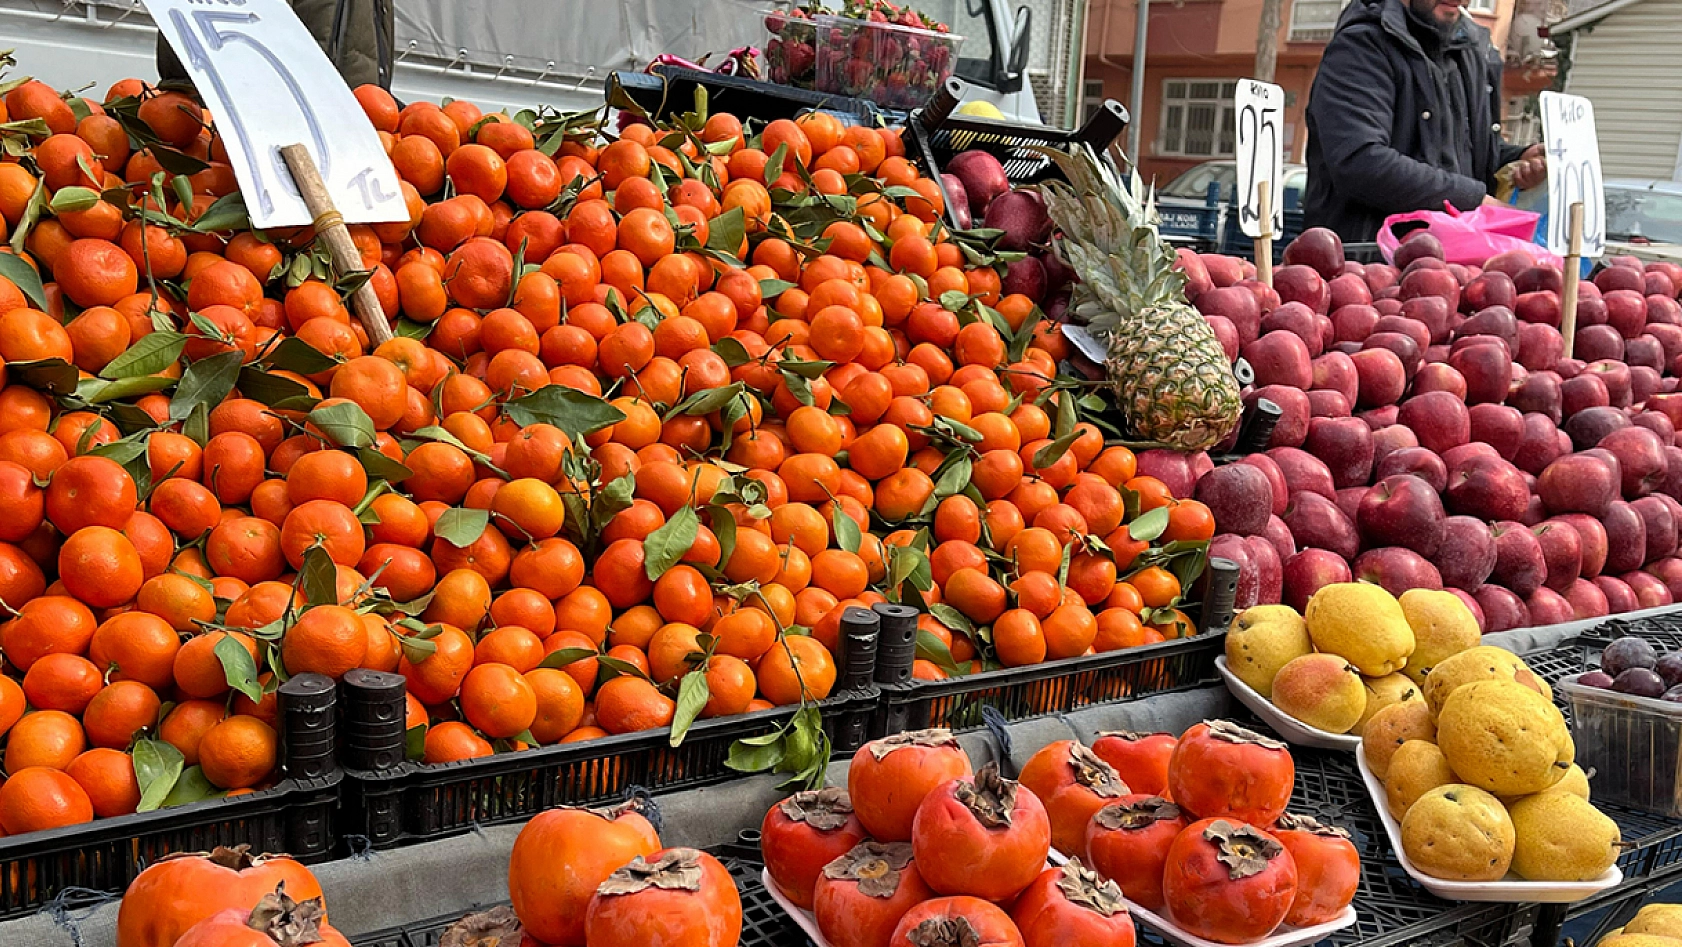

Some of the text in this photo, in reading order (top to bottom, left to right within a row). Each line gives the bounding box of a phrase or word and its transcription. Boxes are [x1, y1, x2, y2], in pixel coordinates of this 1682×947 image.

[168, 8, 330, 220] 15
[1240, 104, 1277, 223] 25
[346, 166, 398, 211] TL
[1553, 160, 1598, 248] 100
